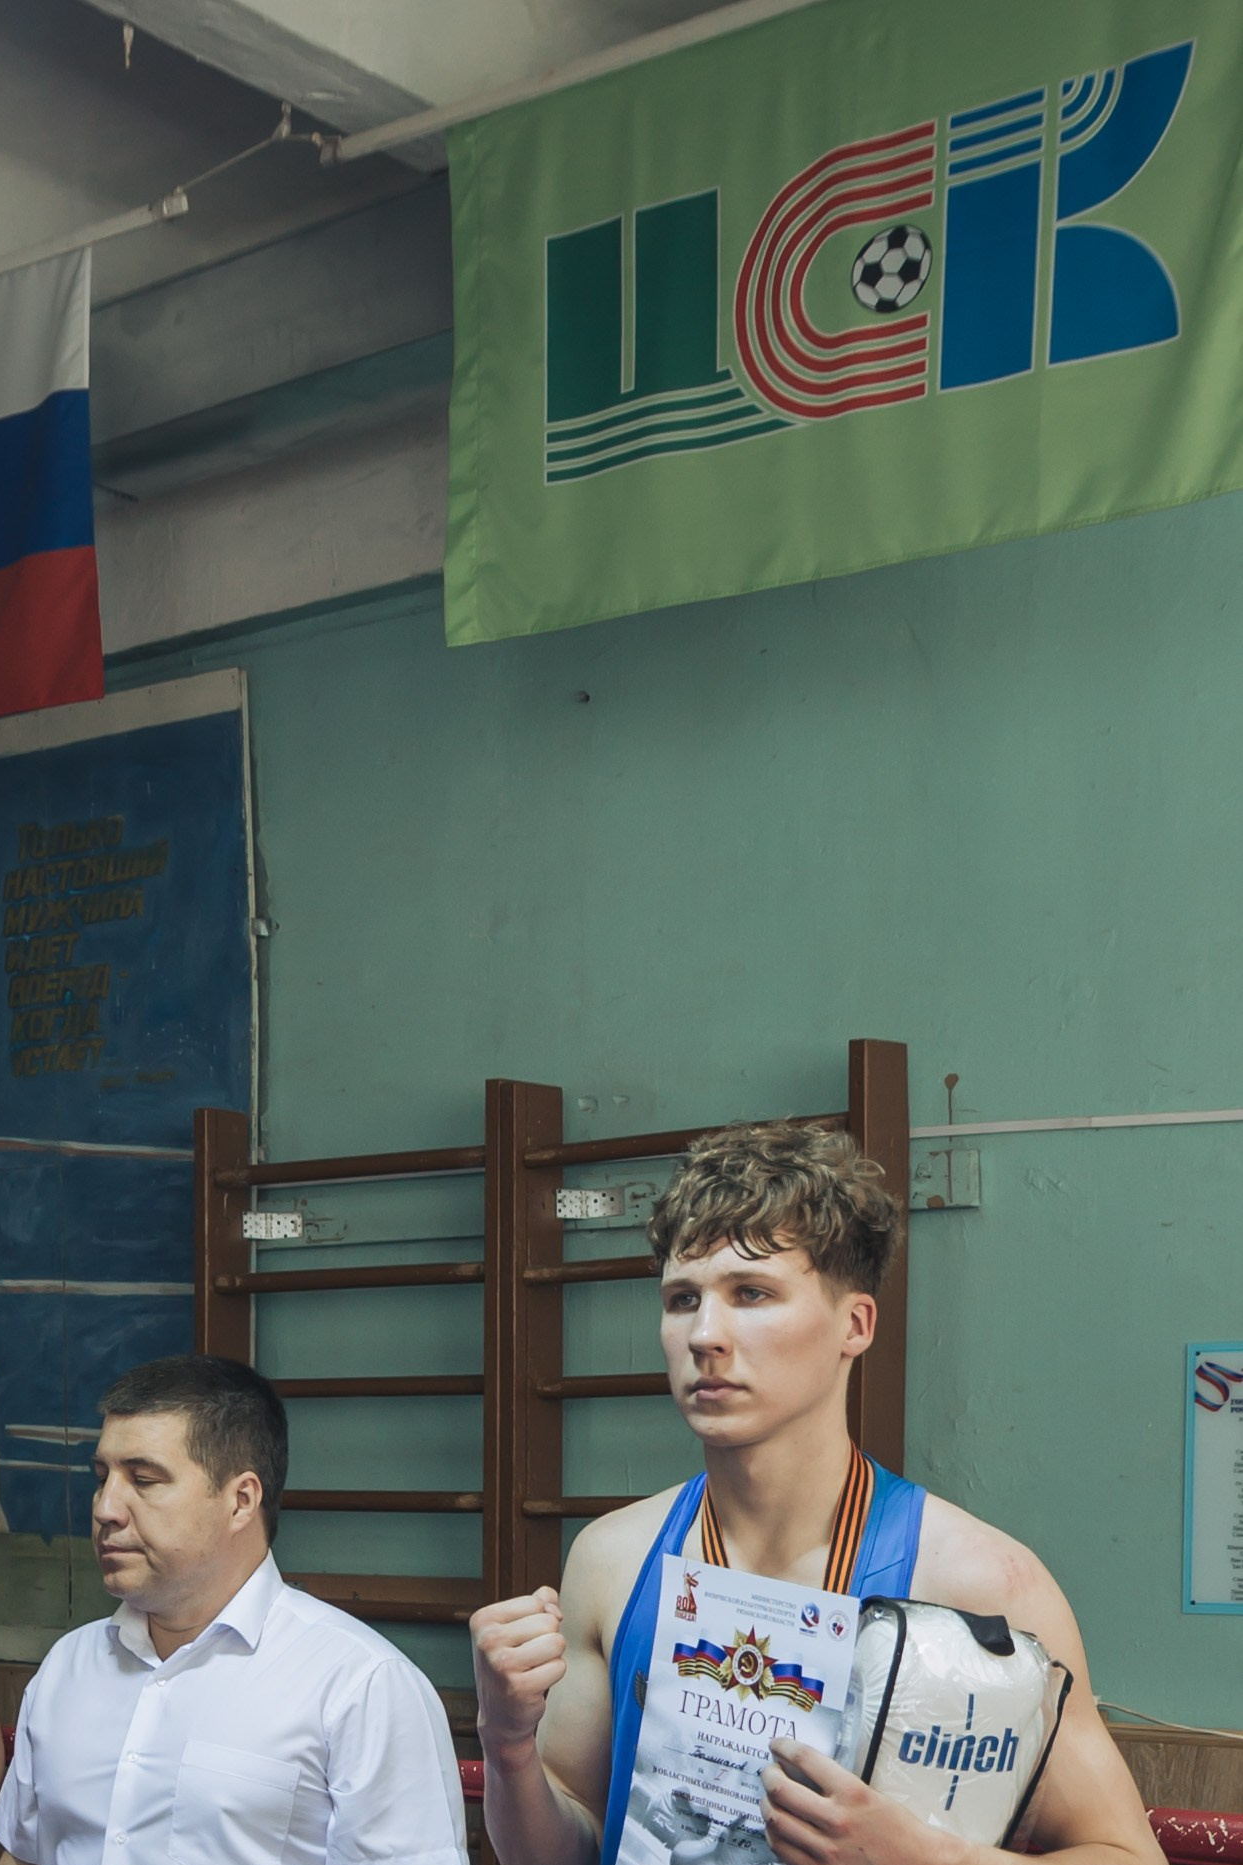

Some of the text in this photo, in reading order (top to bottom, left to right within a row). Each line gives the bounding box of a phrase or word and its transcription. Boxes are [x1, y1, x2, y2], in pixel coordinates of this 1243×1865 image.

[678, 1689, 797, 1740] ГРАМОТА
[697, 1731, 770, 1761] НАГРАЖДАЕТСЯ
[899, 1726, 1020, 1775] clinch
[701, 1780, 761, 1805] СОРЕВНОВАНИЯ
